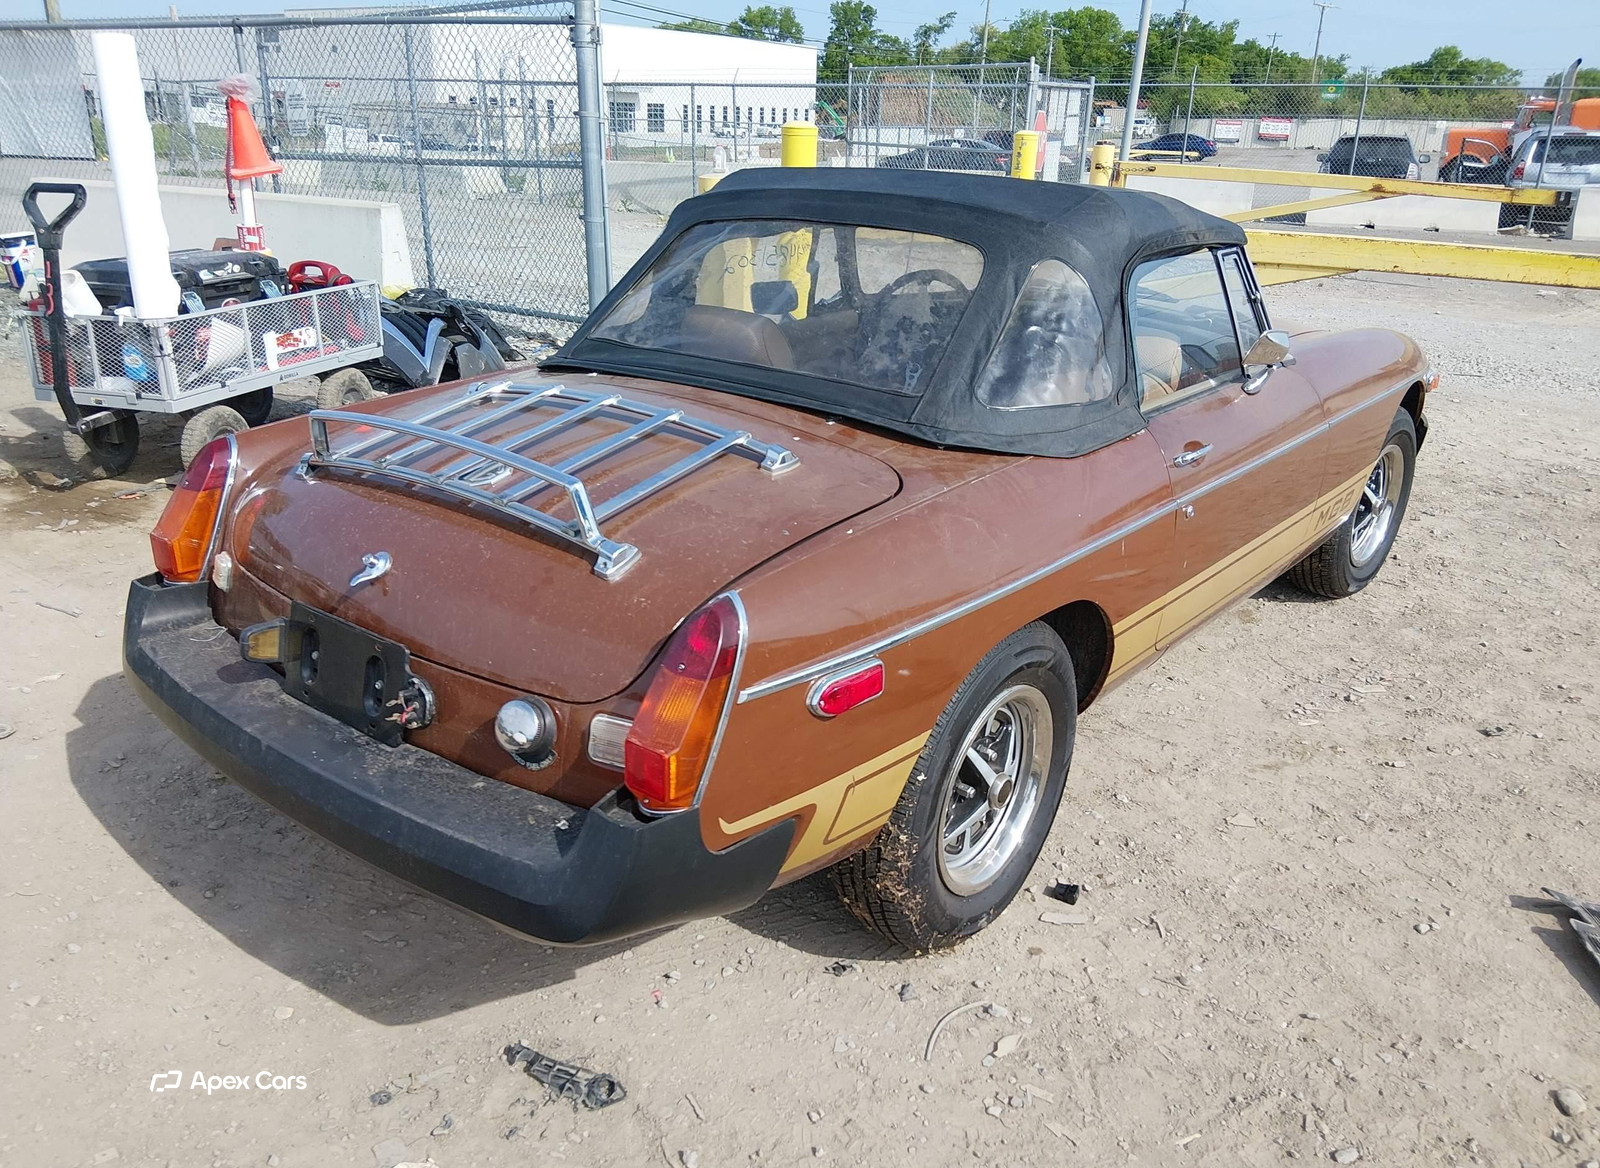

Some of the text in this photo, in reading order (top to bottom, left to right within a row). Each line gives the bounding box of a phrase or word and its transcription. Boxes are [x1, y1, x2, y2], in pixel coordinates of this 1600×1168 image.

[284, 372, 299, 380] GORILLA
[1314, 489, 1355, 532] MGB
[526, 762, 541, 771] FUEL
